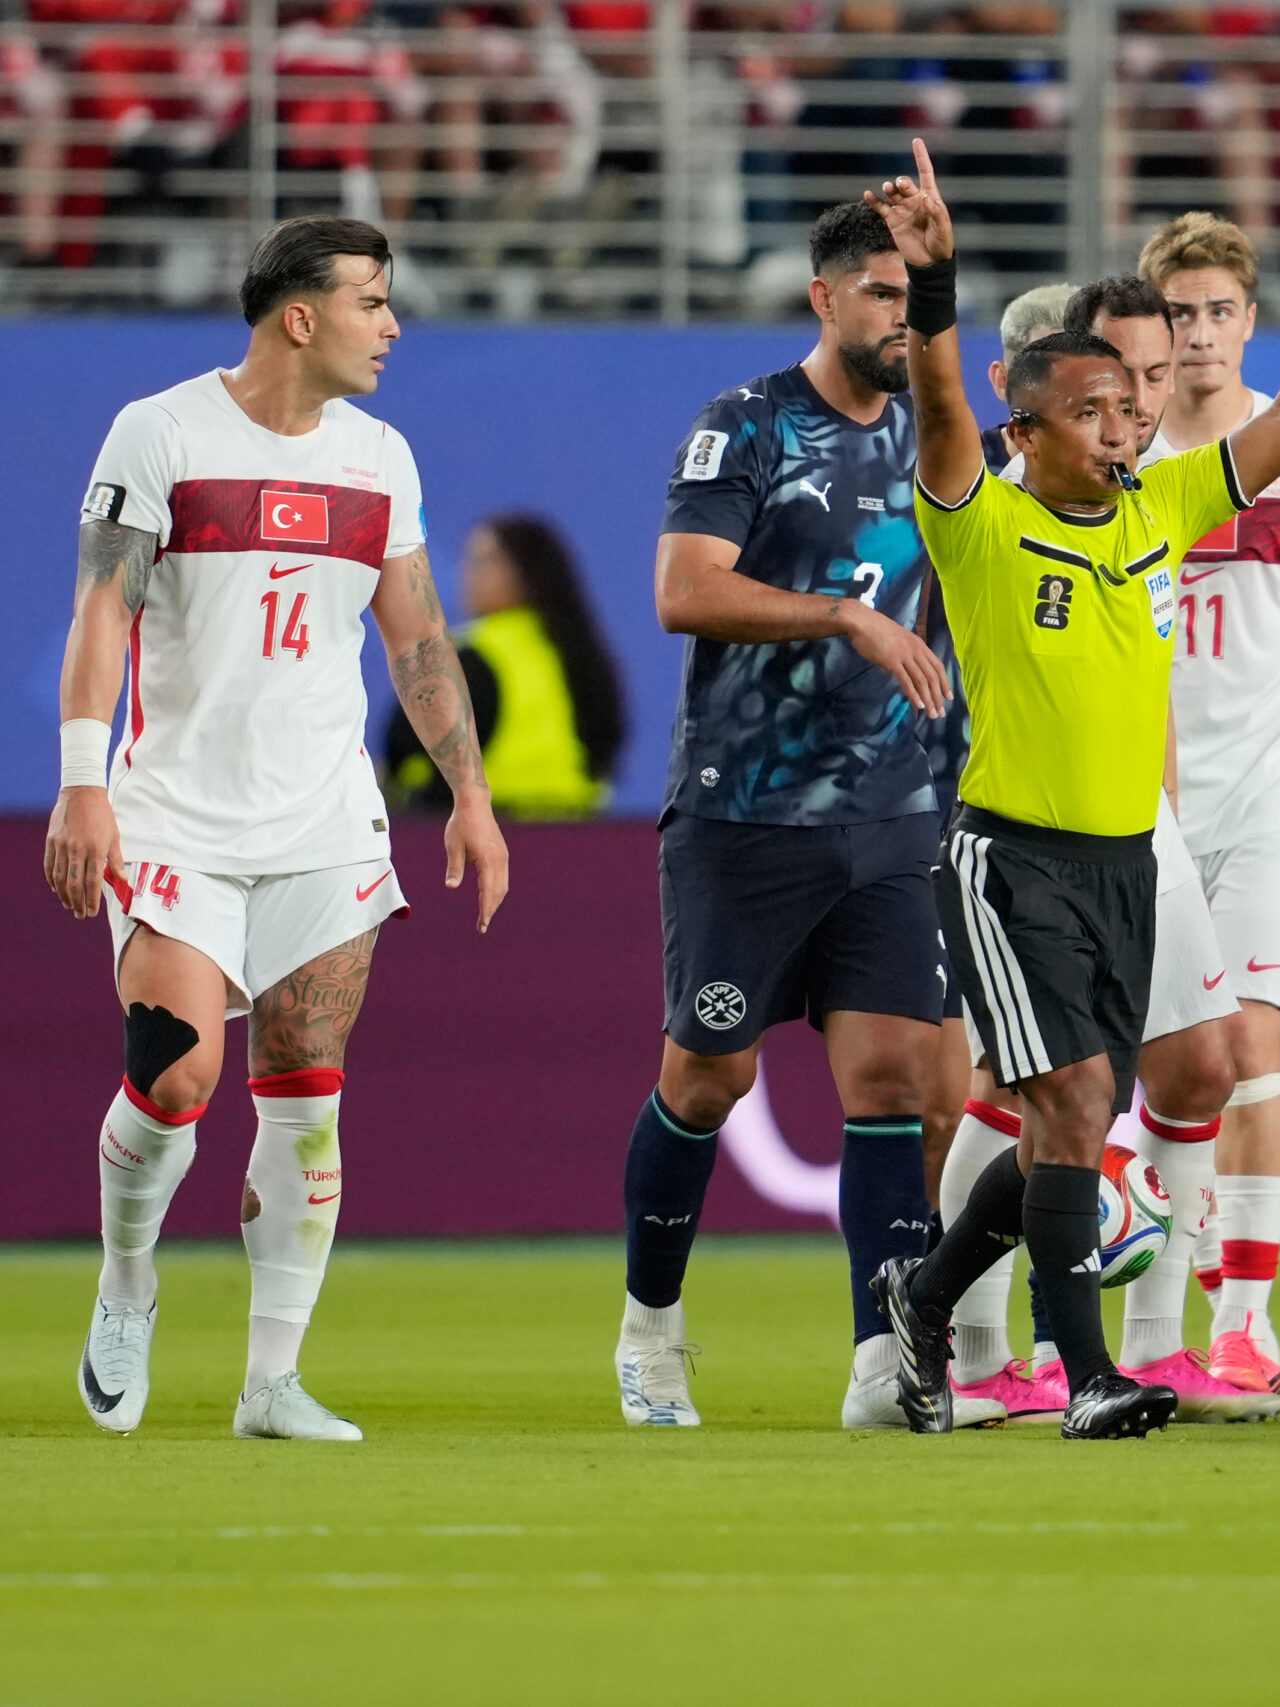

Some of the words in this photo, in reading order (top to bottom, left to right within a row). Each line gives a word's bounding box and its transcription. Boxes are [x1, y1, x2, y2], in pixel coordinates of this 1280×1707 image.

[853, 562, 884, 610] 3
[1148, 572, 1171, 596] FIFA
[1042, 616, 1061, 626] FIFA
[1153, 598, 1174, 615] REFEREE
[260, 590, 311, 662] 14
[1178, 593, 1225, 660] 11
[133, 861, 182, 912] 14
[713, 986, 730, 995] APF
